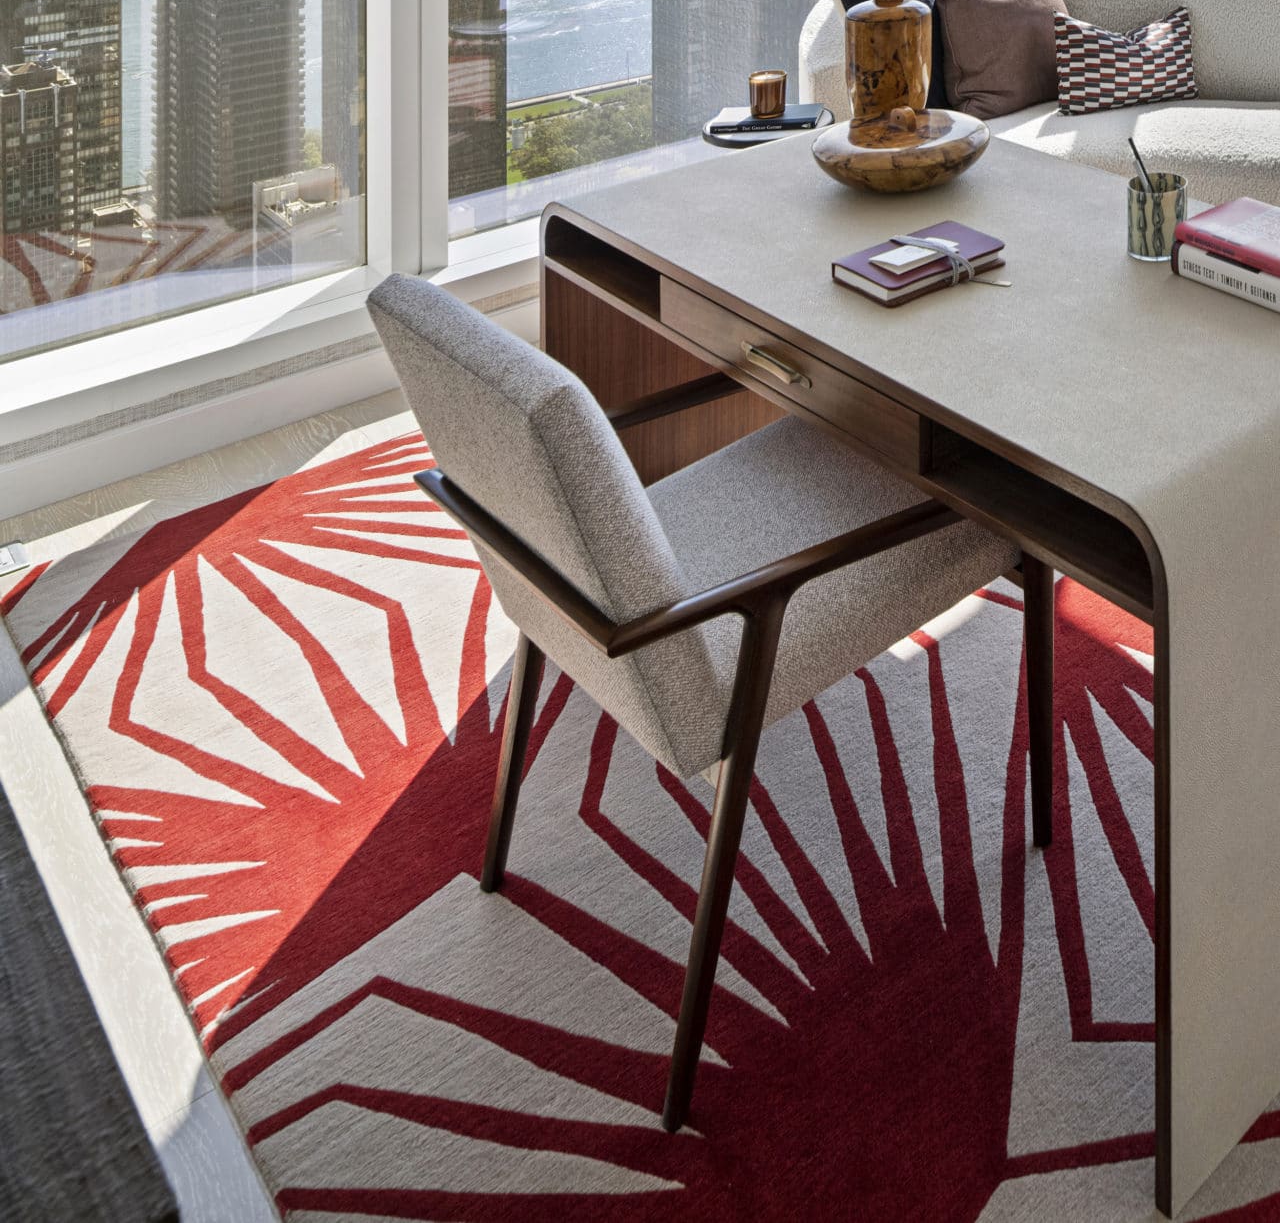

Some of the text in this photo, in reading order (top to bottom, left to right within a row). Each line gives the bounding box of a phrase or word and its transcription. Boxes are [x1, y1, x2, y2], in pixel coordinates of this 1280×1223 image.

[1183, 260, 1201, 275] STRESS
[1203, 266, 1215, 281] TEST
[1221, 274, 1243, 291] TIMOTHY
